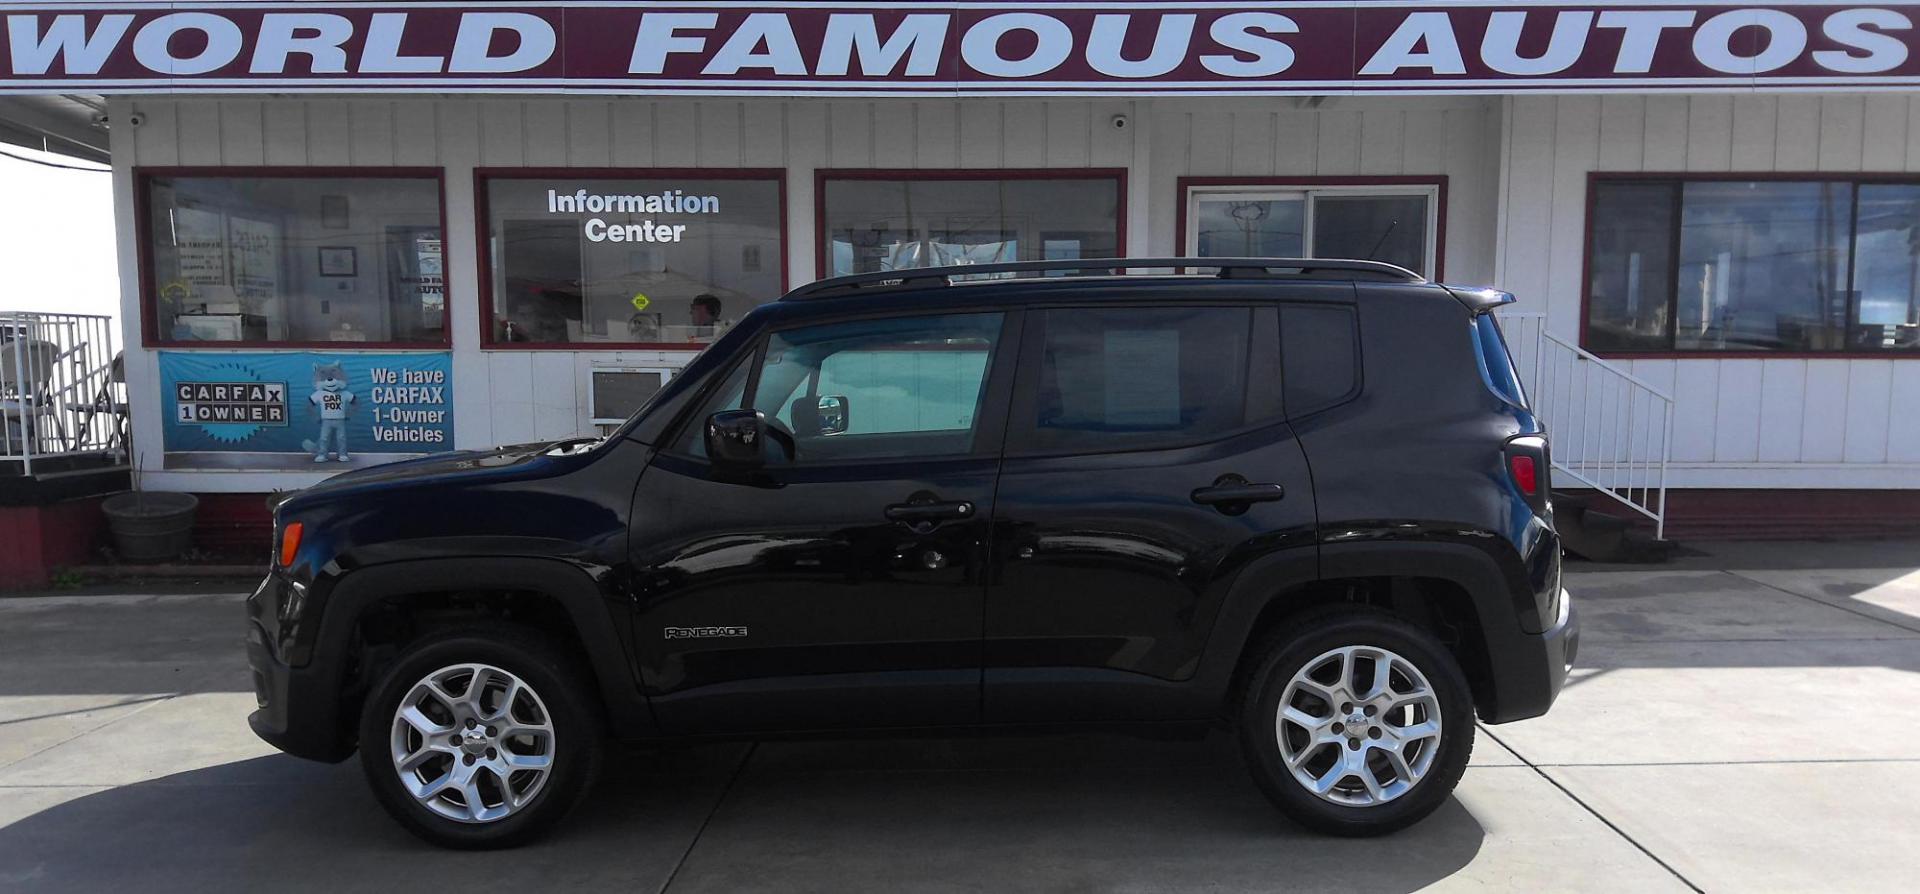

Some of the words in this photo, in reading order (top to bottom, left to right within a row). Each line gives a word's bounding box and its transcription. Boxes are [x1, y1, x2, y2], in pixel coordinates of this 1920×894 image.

[7, 12, 557, 75] WORLD
[627, 11, 1300, 78] FAMOUS
[1357, 8, 1913, 76] AUTOS
[548, 189, 719, 213] Information
[584, 218, 686, 243] Center
[370, 367, 397, 384] We
[402, 367, 444, 384] have
[178, 385, 283, 402] CARFAX
[322, 394, 342, 402] CAR
[371, 387, 444, 404] CARFAX
[182, 406, 192, 420] 1
[198, 406, 283, 420] OWNER
[324, 402, 342, 411] FOX
[372, 407, 444, 424] 1-Owner
[372, 426, 444, 442] Vehicles
[664, 626, 748, 639] RENEGADE
